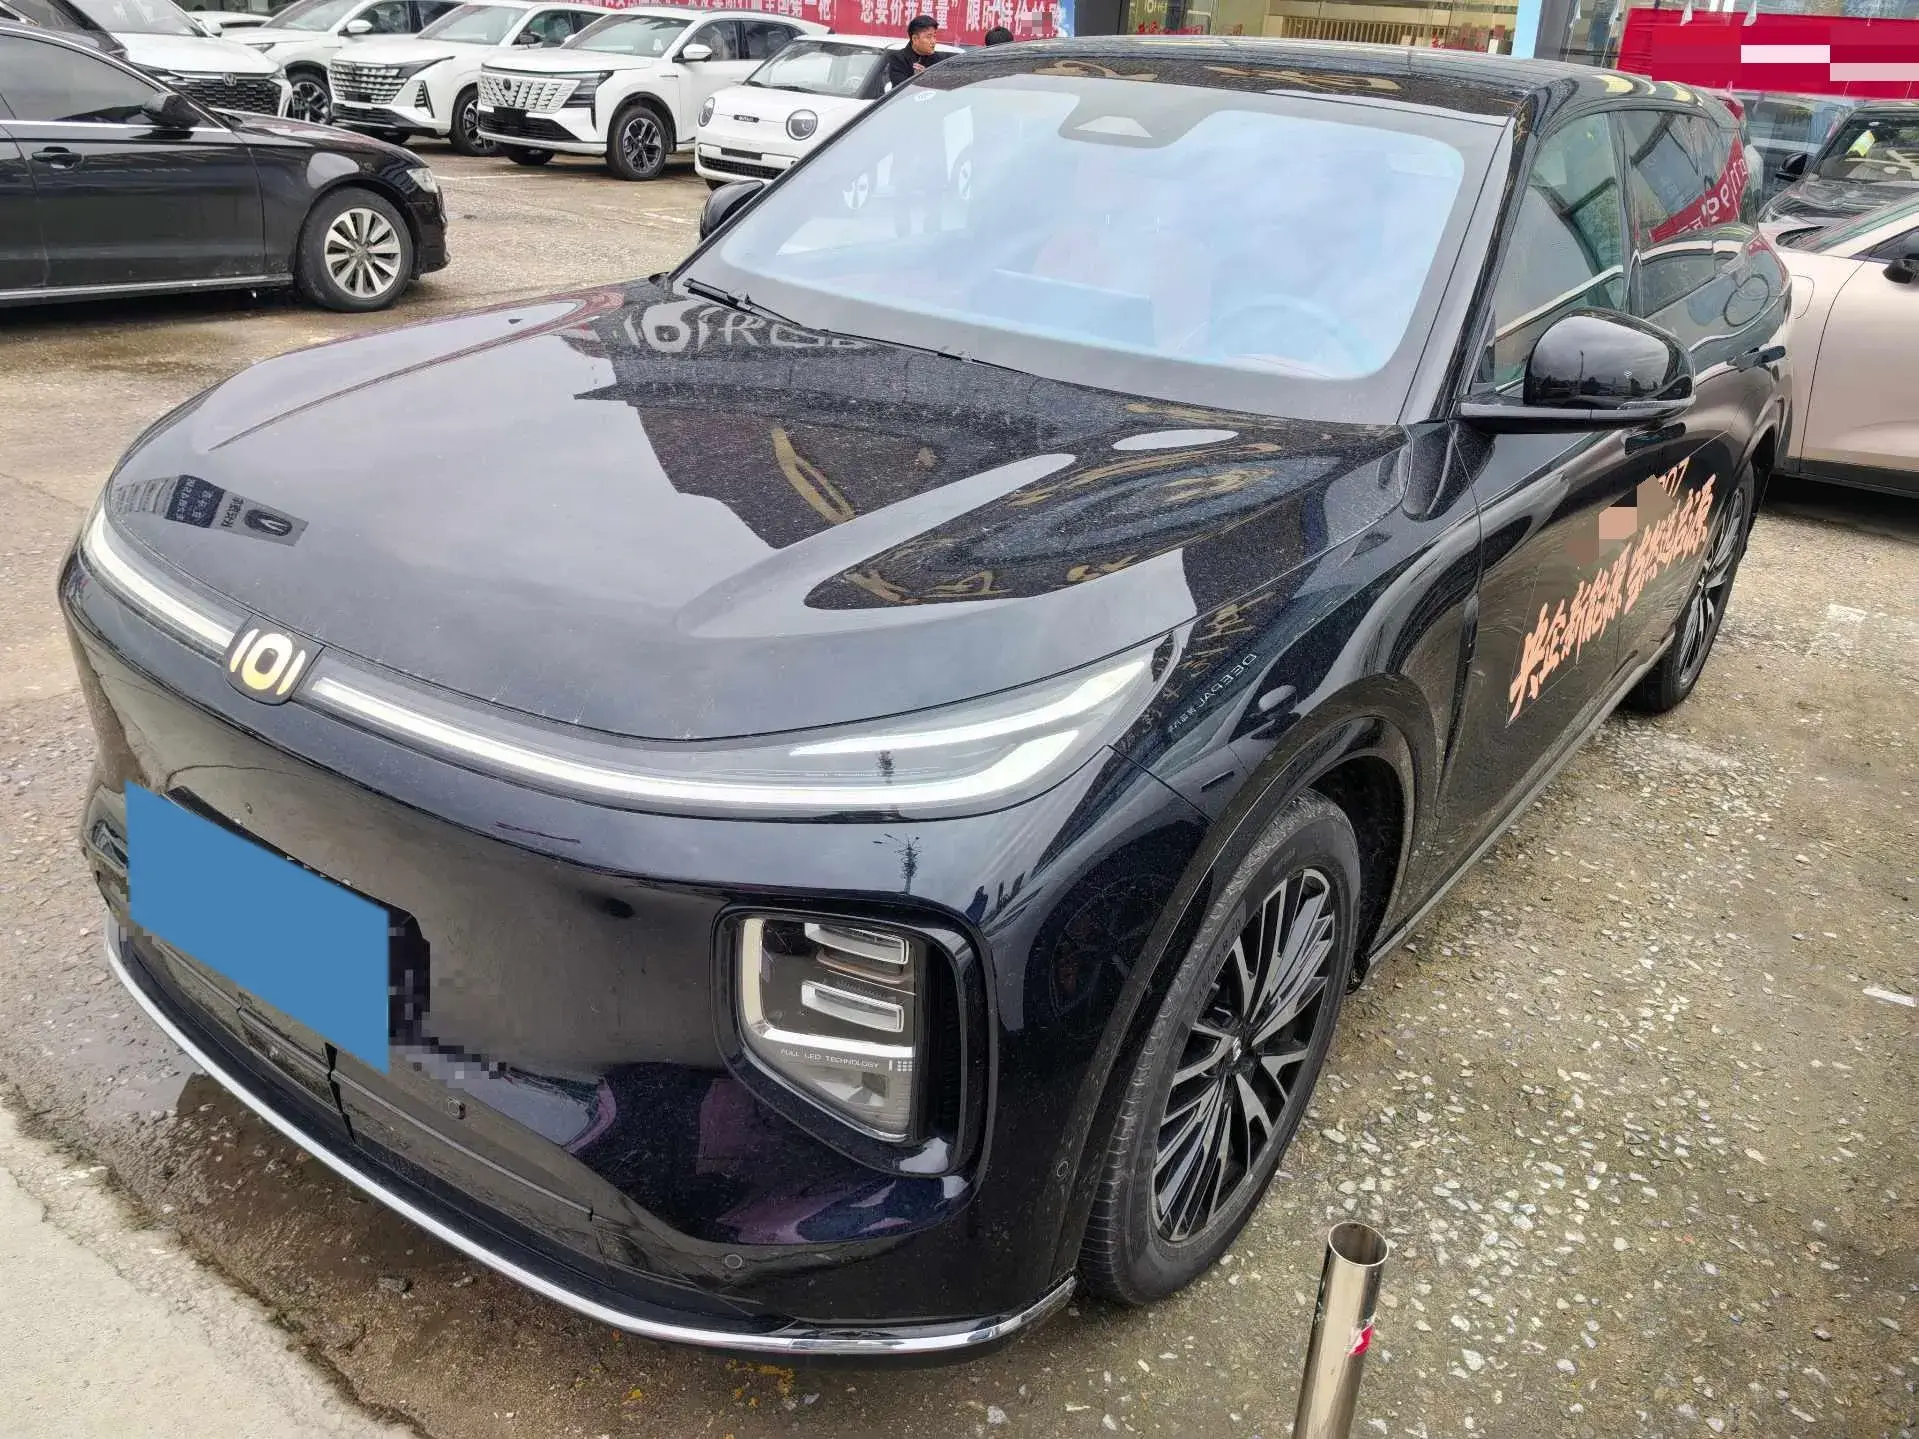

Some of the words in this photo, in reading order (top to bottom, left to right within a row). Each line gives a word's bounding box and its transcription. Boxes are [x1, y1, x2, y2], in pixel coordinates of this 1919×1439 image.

[780, 1048, 800, 1057] FULL
[804, 1052, 822, 1061] LED
[824, 1055, 880, 1069] TECHNOLOGY
